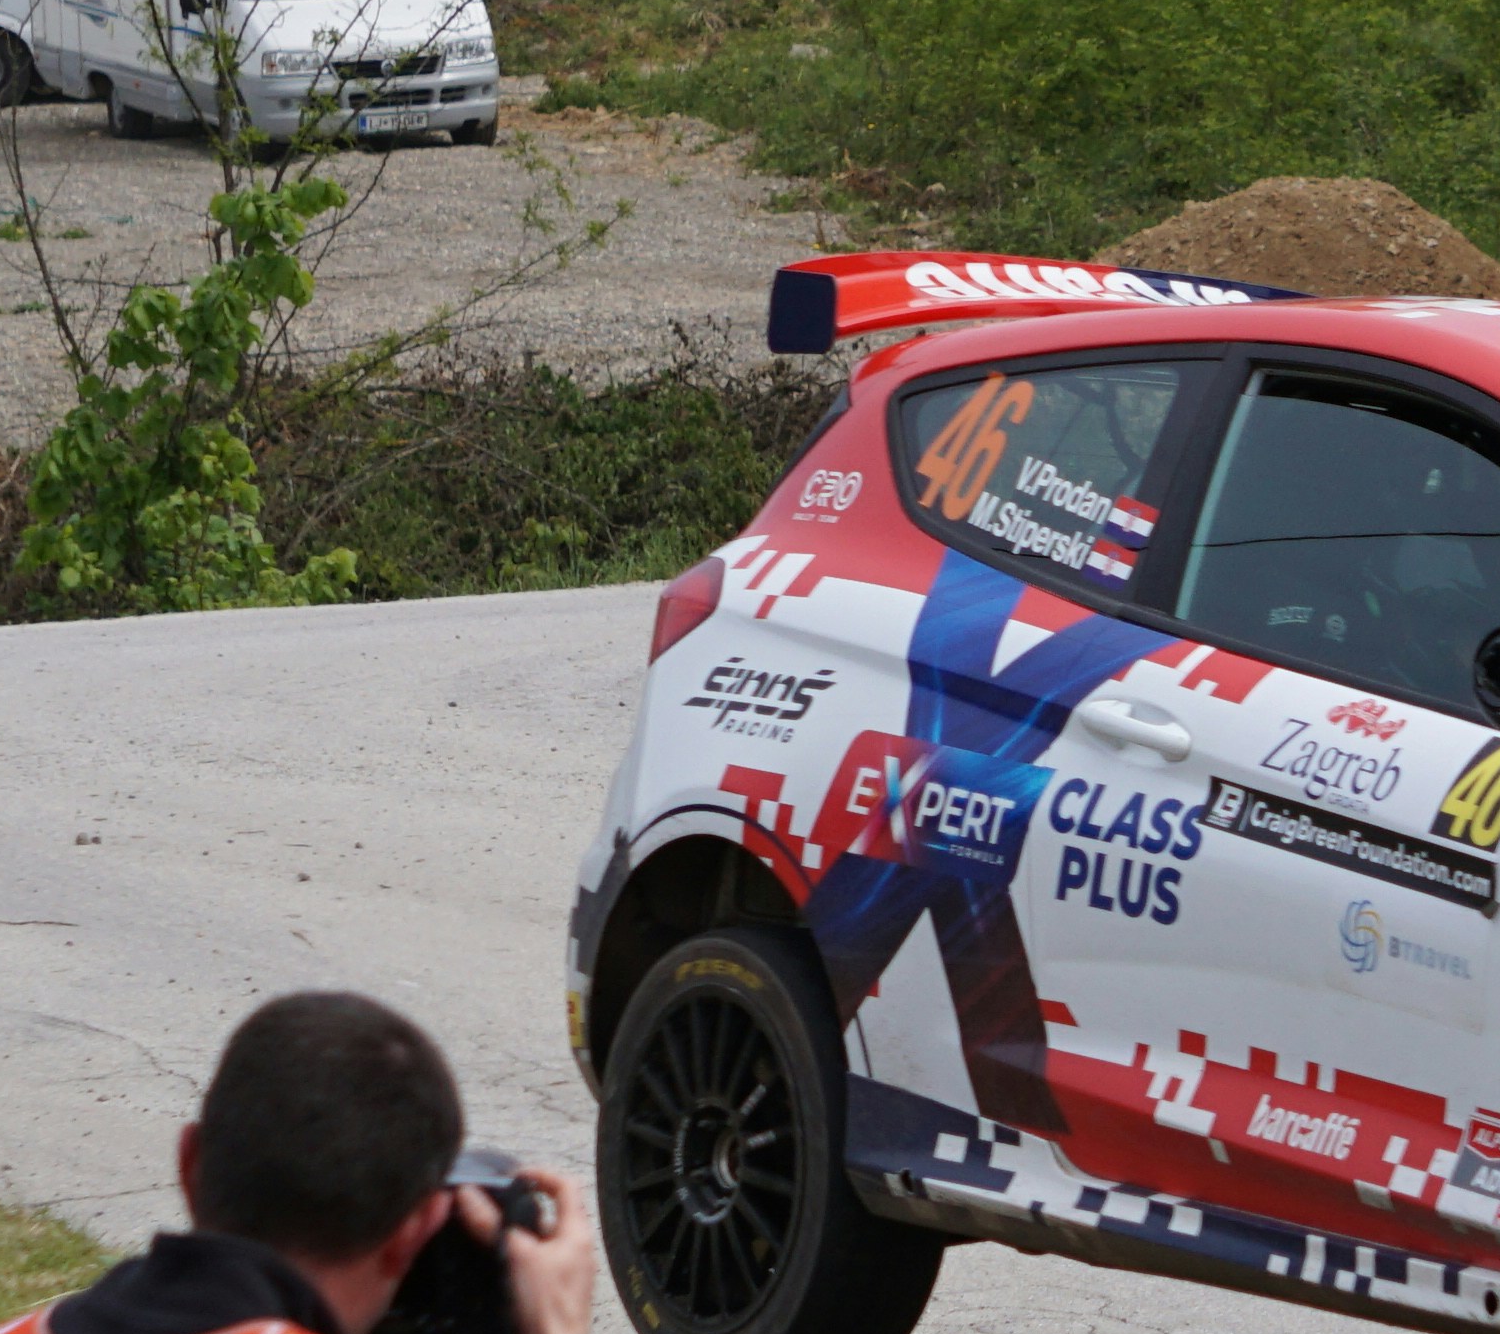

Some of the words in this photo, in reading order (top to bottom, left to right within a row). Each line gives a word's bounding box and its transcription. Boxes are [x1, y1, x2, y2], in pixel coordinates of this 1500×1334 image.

[917, 371, 1036, 520] 46
[800, 469, 862, 511] CRO
[1015, 456, 1112, 524] V.Prodan
[967, 491, 1095, 570] M.Stiperski
[724, 719, 795, 743] RACING
[1260, 718, 1404, 802] Zagreb
[846, 756, 1016, 855] EXPERT
[1049, 778, 1206, 860] CLASS
[1054, 845, 1181, 925] PLUS
[1250, 800, 1490, 897] CraigBreenFoundation.com
[1246, 1093, 1361, 1160] barcaffé
